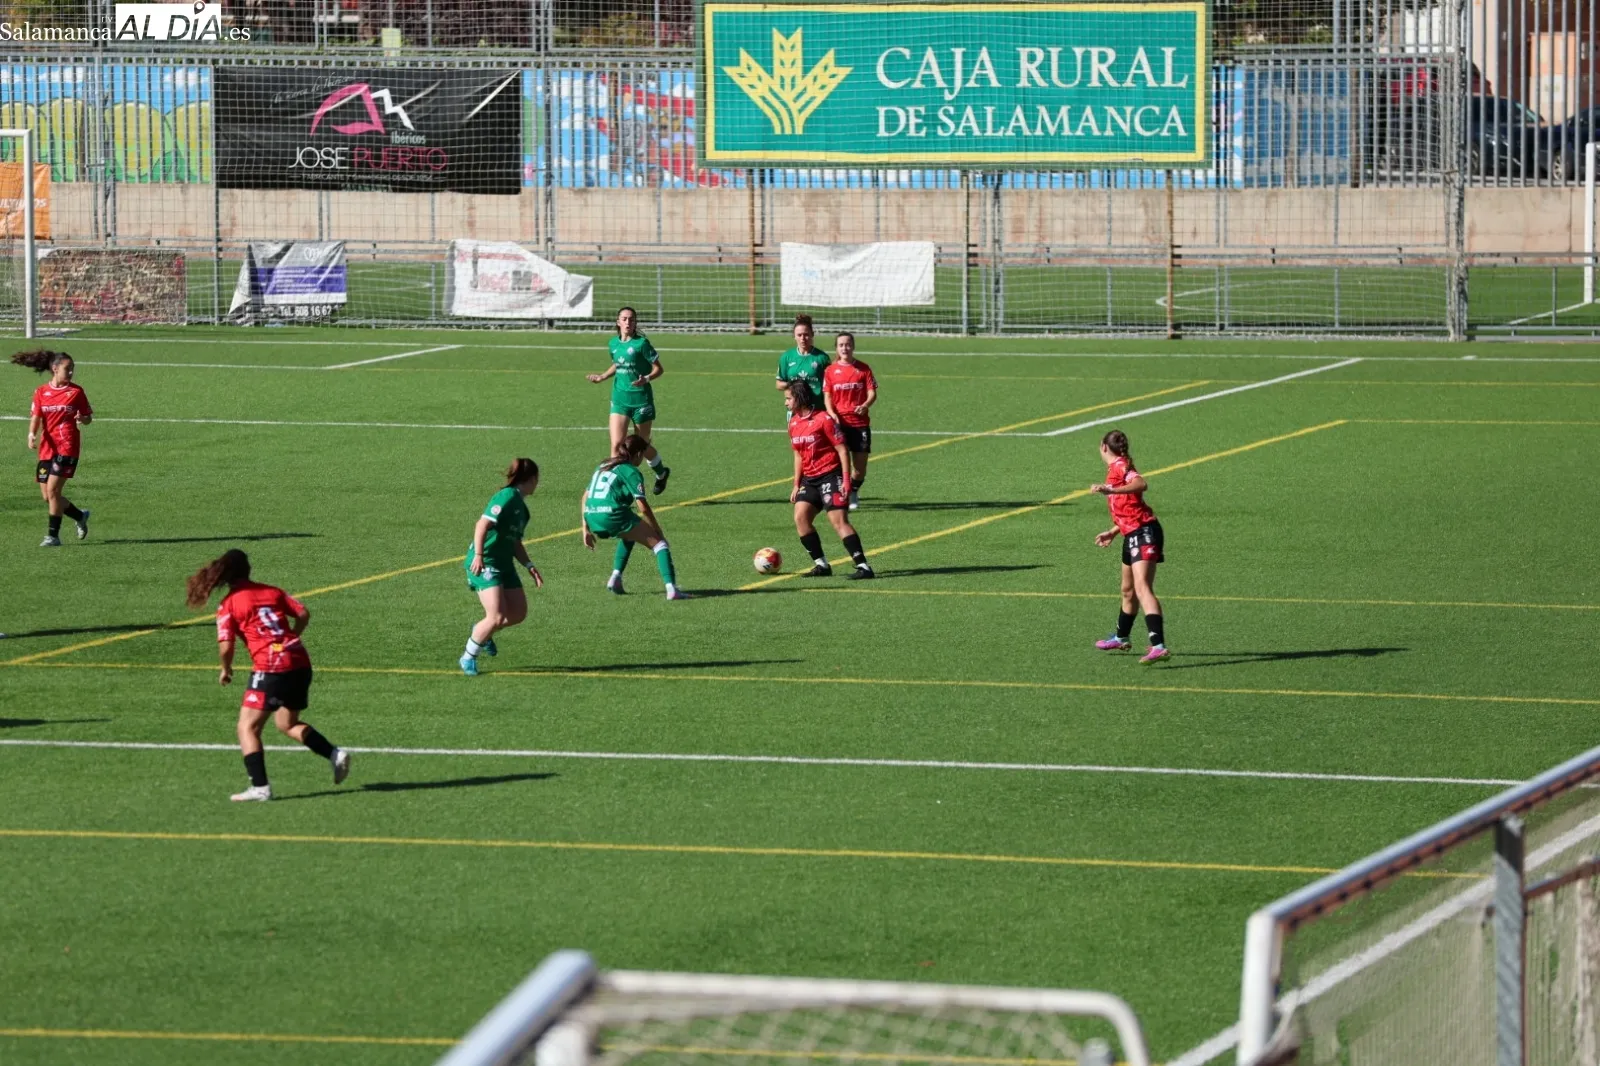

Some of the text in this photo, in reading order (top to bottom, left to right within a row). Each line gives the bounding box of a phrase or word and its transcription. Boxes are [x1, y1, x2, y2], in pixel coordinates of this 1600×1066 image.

[876, 46, 1188, 100] CAJA RURAL
[876, 104, 1188, 137] DE SALAMANCA
[391, 130, 427, 145] Ibéricos
[288, 146, 448, 171] JOSE PUERTO
[588, 469, 618, 499] 19
[821, 482, 832, 494] 22
[1128, 535, 1138, 548] 21
